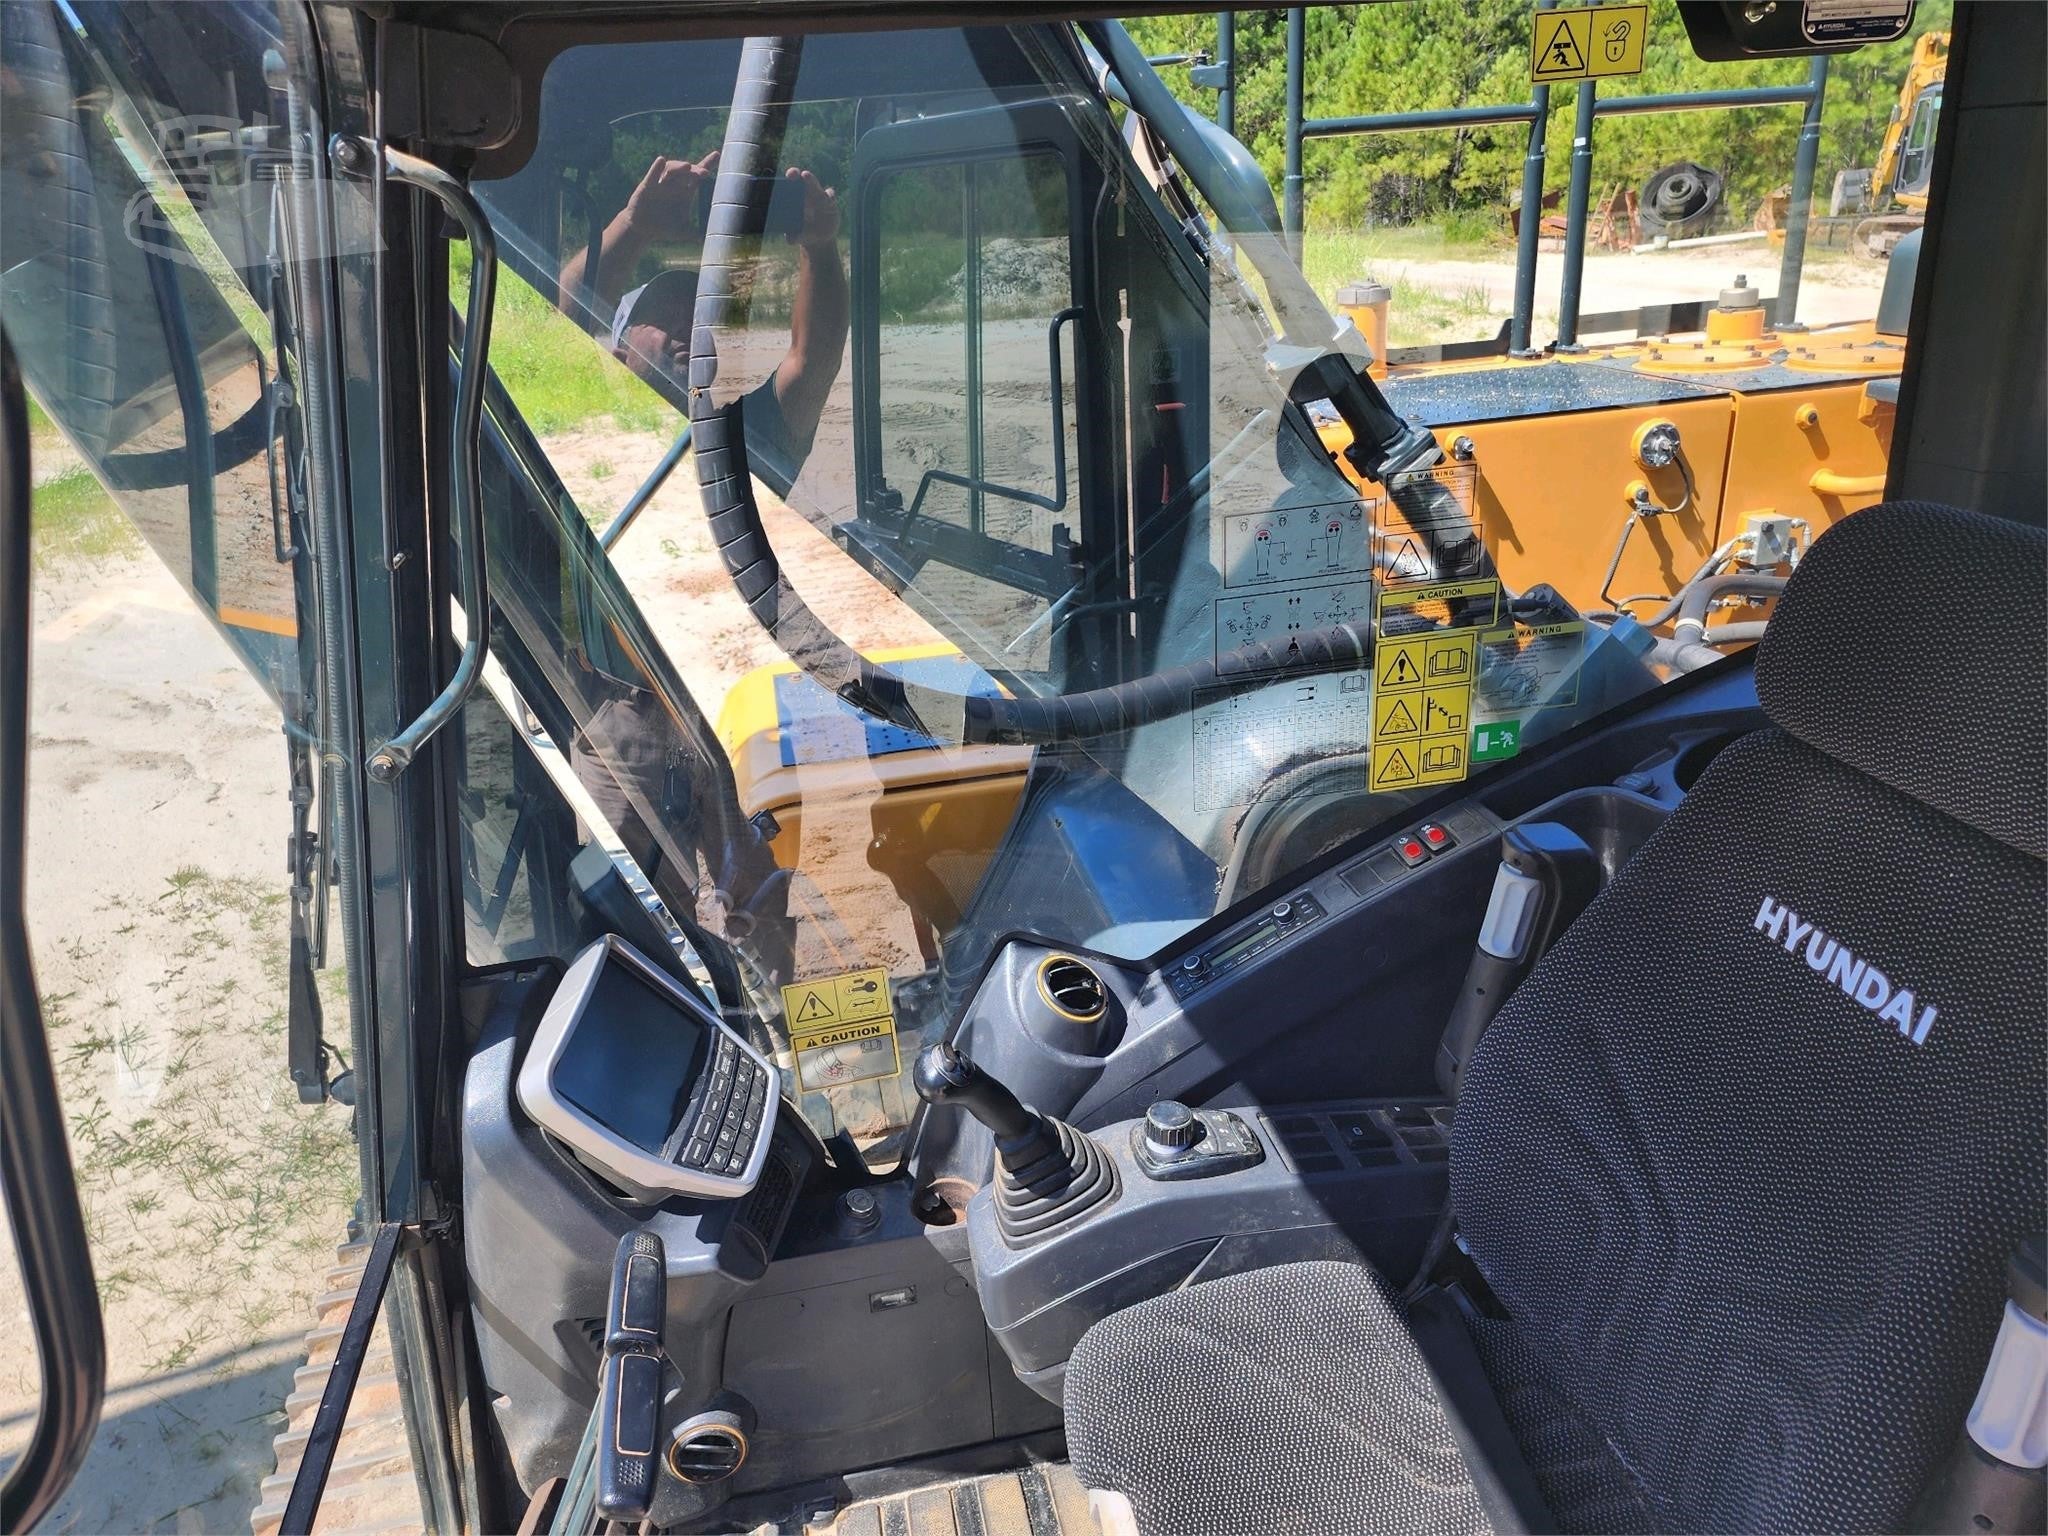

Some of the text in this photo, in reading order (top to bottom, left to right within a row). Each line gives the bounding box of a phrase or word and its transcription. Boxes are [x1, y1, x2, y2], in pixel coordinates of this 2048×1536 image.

[1417, 470, 1455, 480] WARNING
[1427, 588, 1464, 599] CAUTION
[1518, 625, 1563, 638] WARNING
[1753, 896, 1938, 1045] HYUNDAI
[821, 1026, 881, 1045] CAUTION
